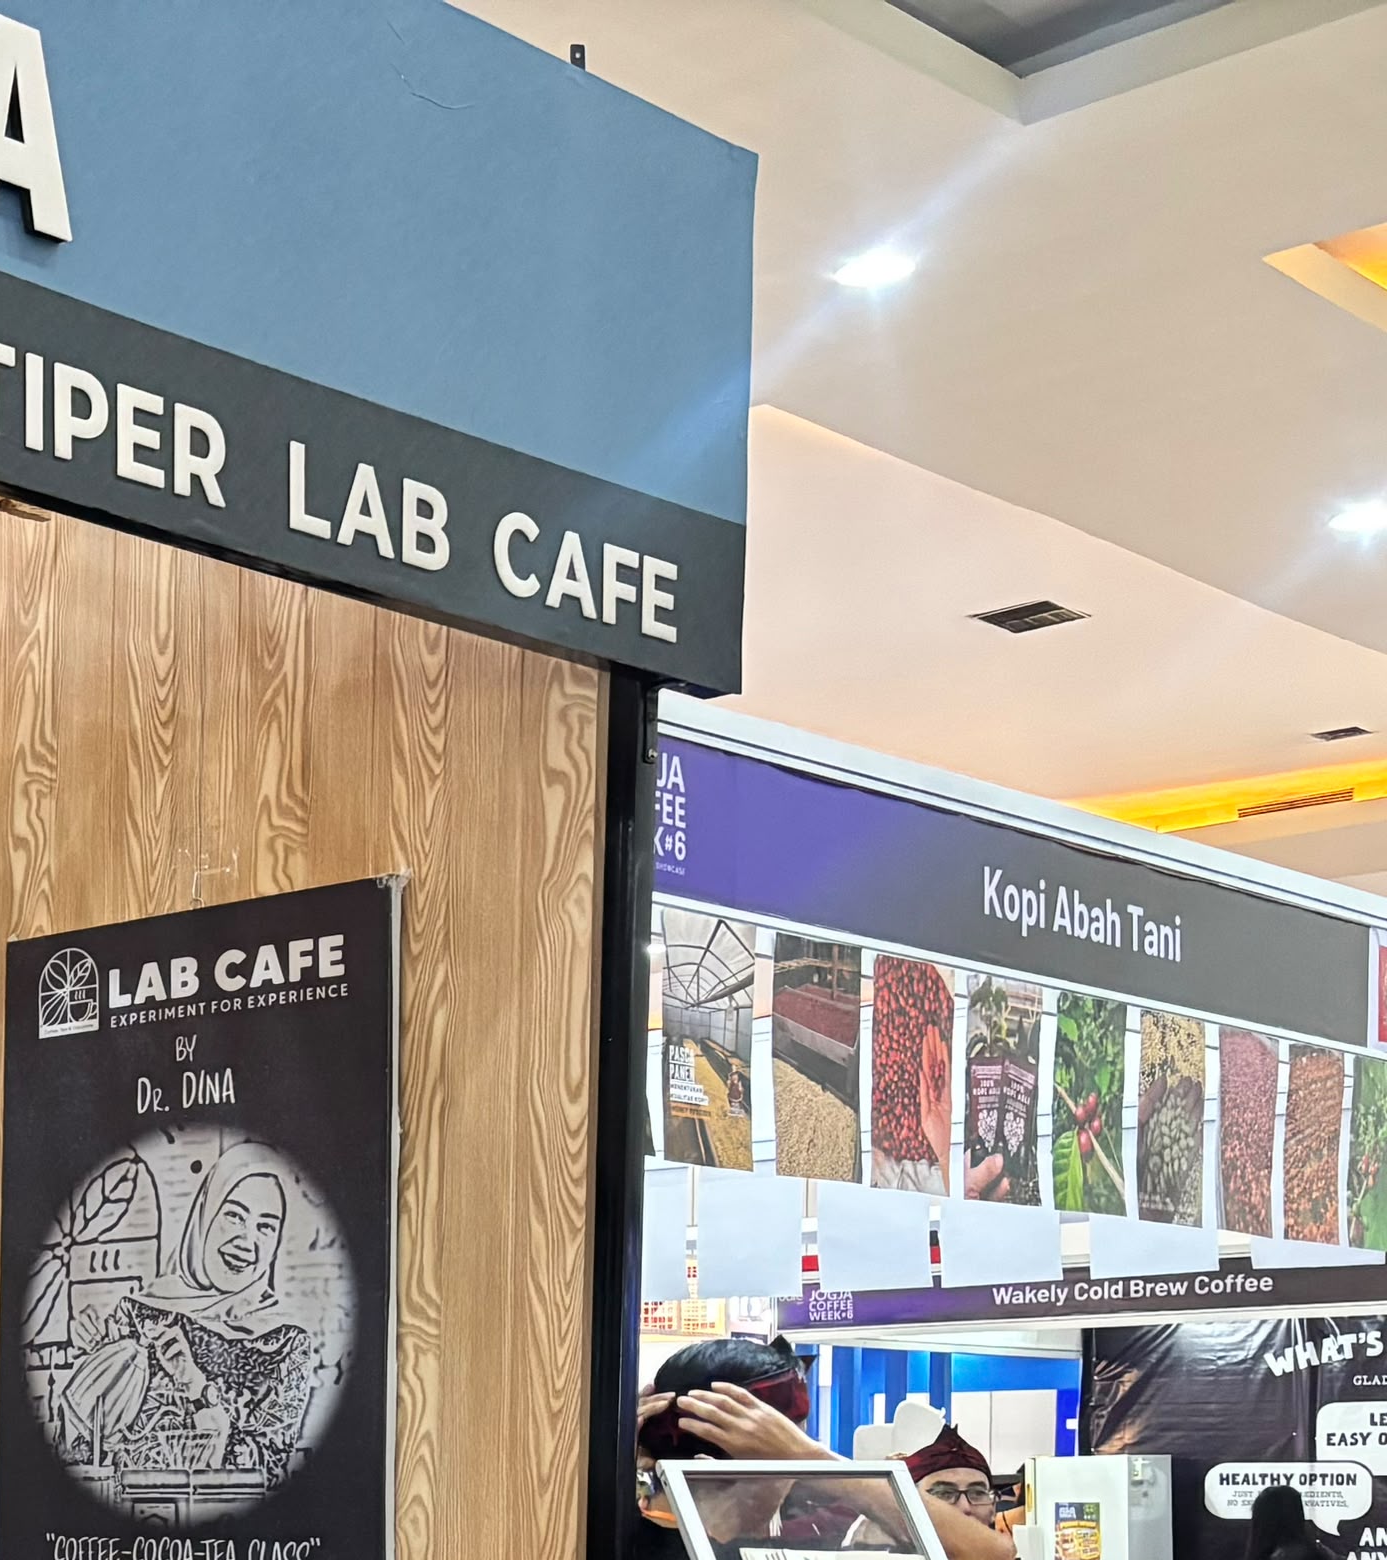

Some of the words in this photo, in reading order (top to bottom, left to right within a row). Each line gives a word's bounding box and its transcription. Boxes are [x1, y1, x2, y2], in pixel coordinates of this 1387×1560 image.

[290, 441, 450, 570] LAB
[494, 512, 677, 643] CAFE
[984, 866, 1045, 937] Kopi
[1053, 886, 1121, 947] Abah
[1127, 904, 1181, 962] Tani
[109, 957, 199, 1008] LAB
[214, 934, 345, 991] CAFE
[111, 1002, 206, 1028] EXPERIMENT
[211, 998, 242, 1013] FOR
[248, 983, 348, 1008] EXPERIENCE
[176, 1034, 197, 1062] BY
[183, 1068, 235, 1108] DINA
[809, 1290, 853, 1301] JOGJA
[809, 1300, 853, 1311] COFFEE
[992, 1284, 1069, 1306] Wakely
[1073, 1278, 1124, 1301] Cold
[1130, 1280, 1188, 1298] Brew
[1195, 1274, 1273, 1294] Coffee
[1264, 1330, 1384, 1377] WHAT'S
[1326, 1432, 1372, 1446] EASY
[1219, 1473, 1294, 1486] HEALTHY
[1299, 1473, 1357, 1486] OPTION
